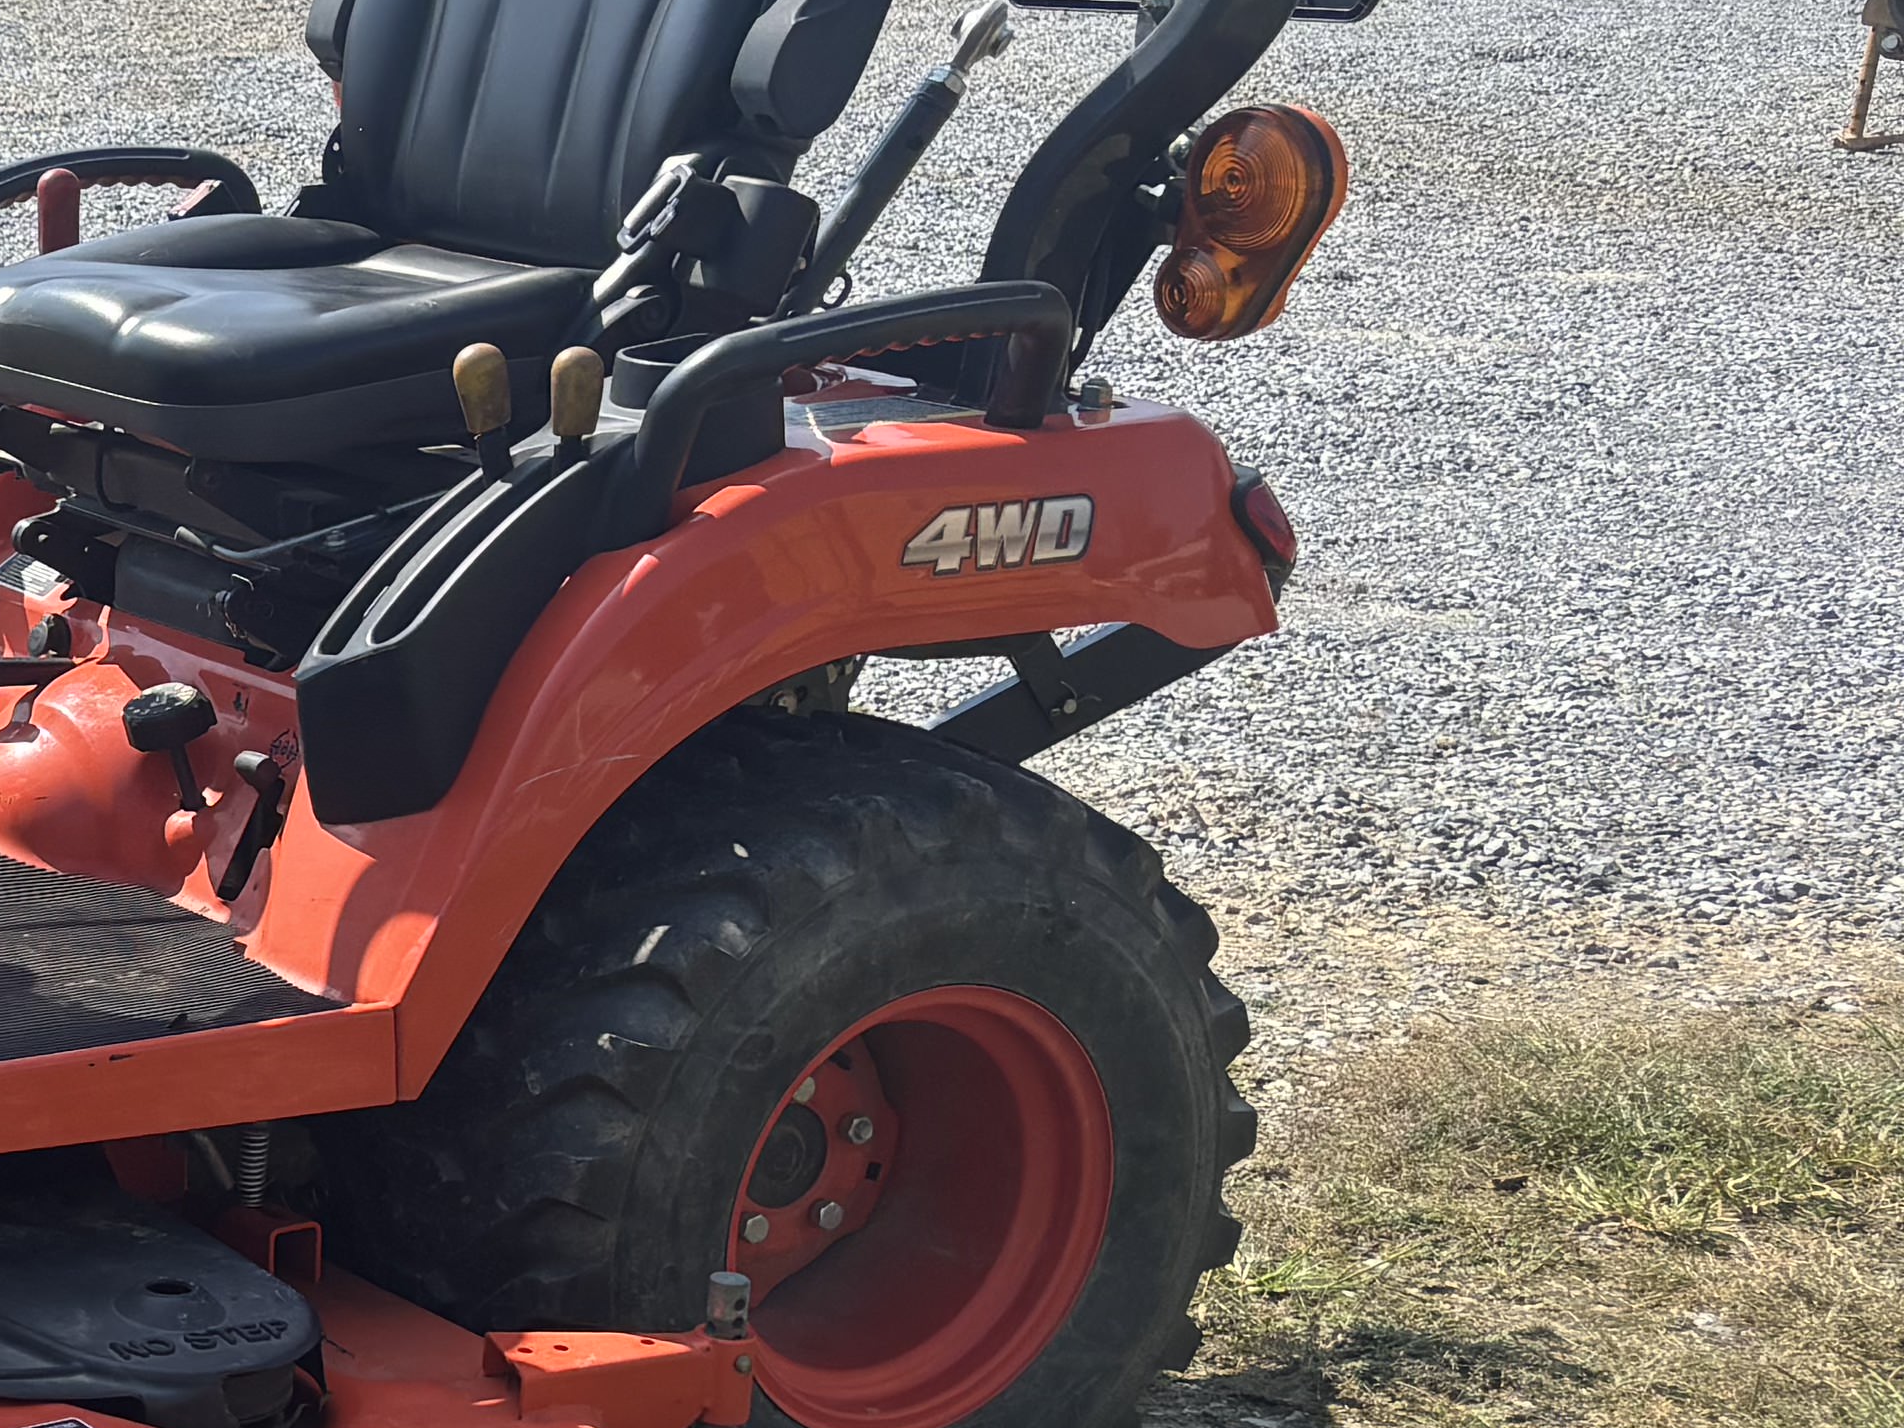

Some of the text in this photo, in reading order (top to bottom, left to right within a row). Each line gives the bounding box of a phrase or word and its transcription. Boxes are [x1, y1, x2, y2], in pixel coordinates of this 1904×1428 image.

[900, 493, 1095, 576] 4WD
[109, 1320, 288, 1360] NO STEP
